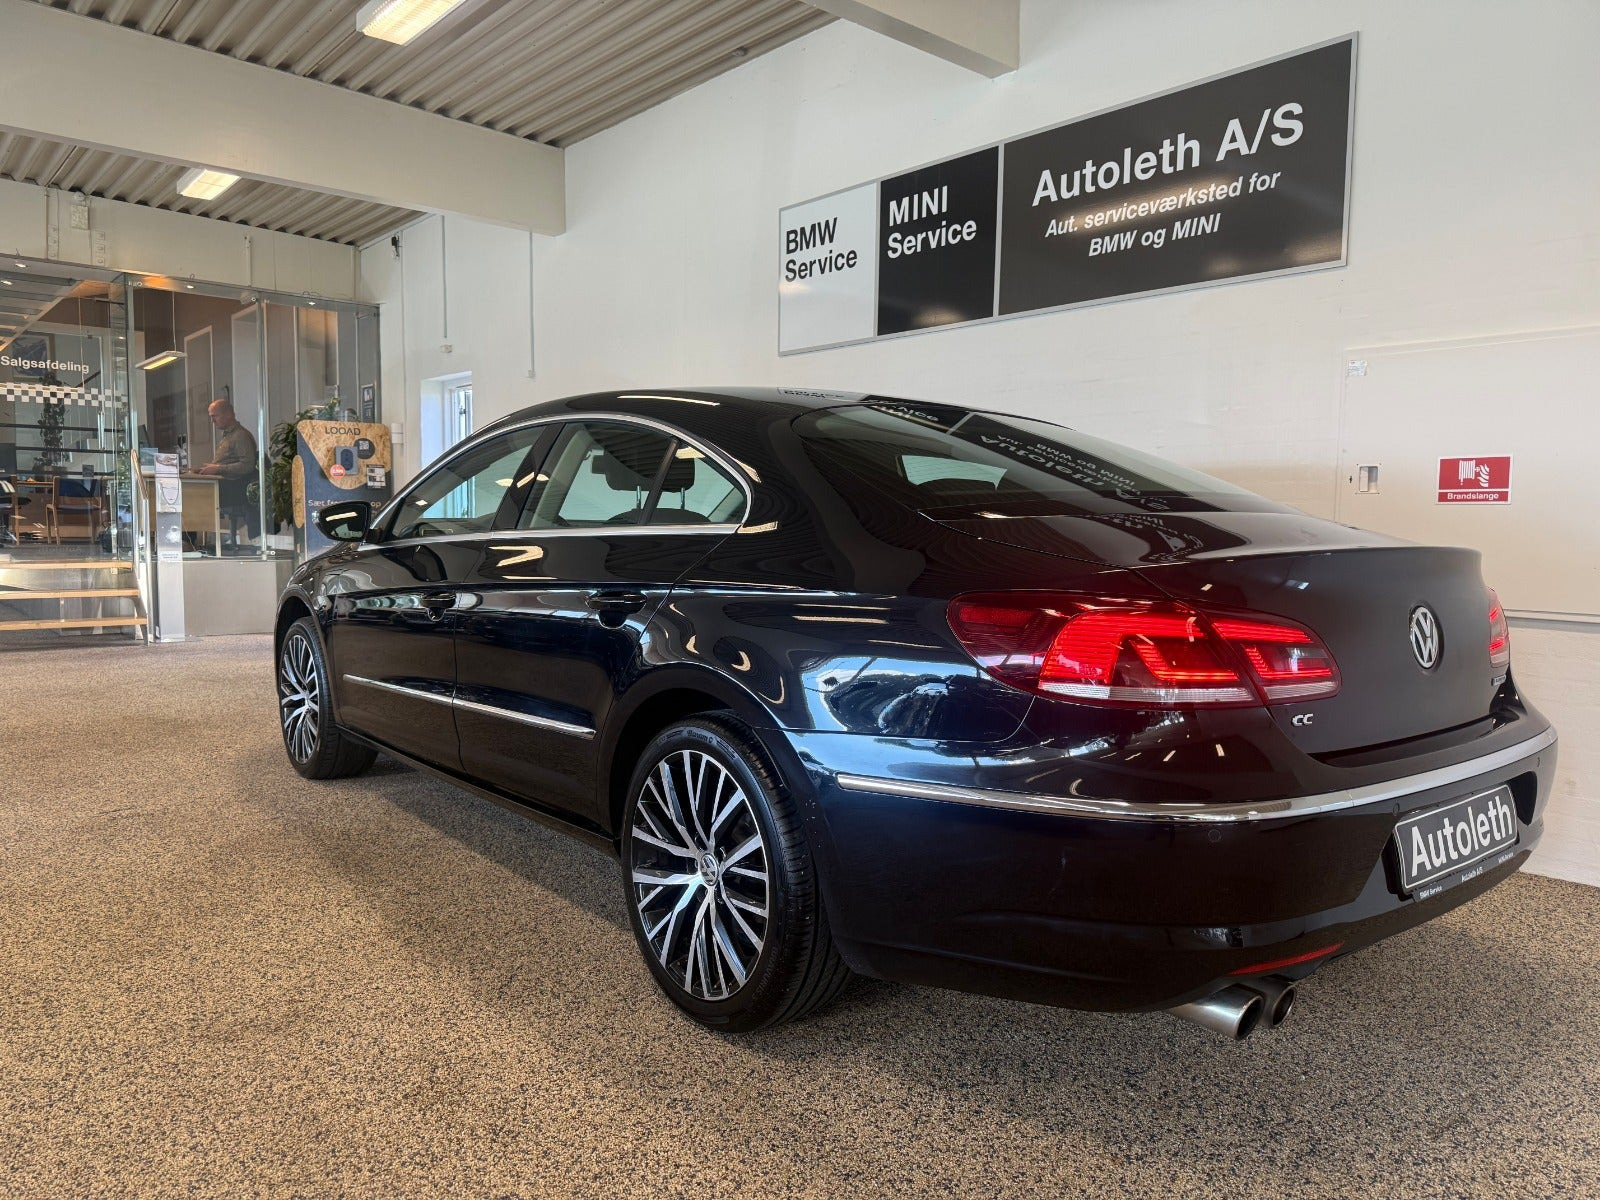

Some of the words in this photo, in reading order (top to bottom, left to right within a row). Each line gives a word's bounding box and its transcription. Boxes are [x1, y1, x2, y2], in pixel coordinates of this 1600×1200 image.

[1032, 132, 1201, 207] Autoleth
[1216, 100, 1304, 163] A/S
[888, 185, 948, 227] MINI
[1045, 214, 1078, 238] Aut.
[1083, 180, 1241, 231] serviceværksted
[1248, 171, 1281, 194] for
[785, 217, 838, 253] BMW
[887, 215, 977, 260] Service
[1089, 229, 1137, 257] BMW
[1141, 226, 1166, 251] og
[1171, 213, 1221, 241] MINI
[785, 247, 858, 283] Service
[0, 355, 89, 374] Salgsafdeling
[1447, 492, 1499, 501] Brandslange
[1411, 795, 1513, 877] Autoleth
